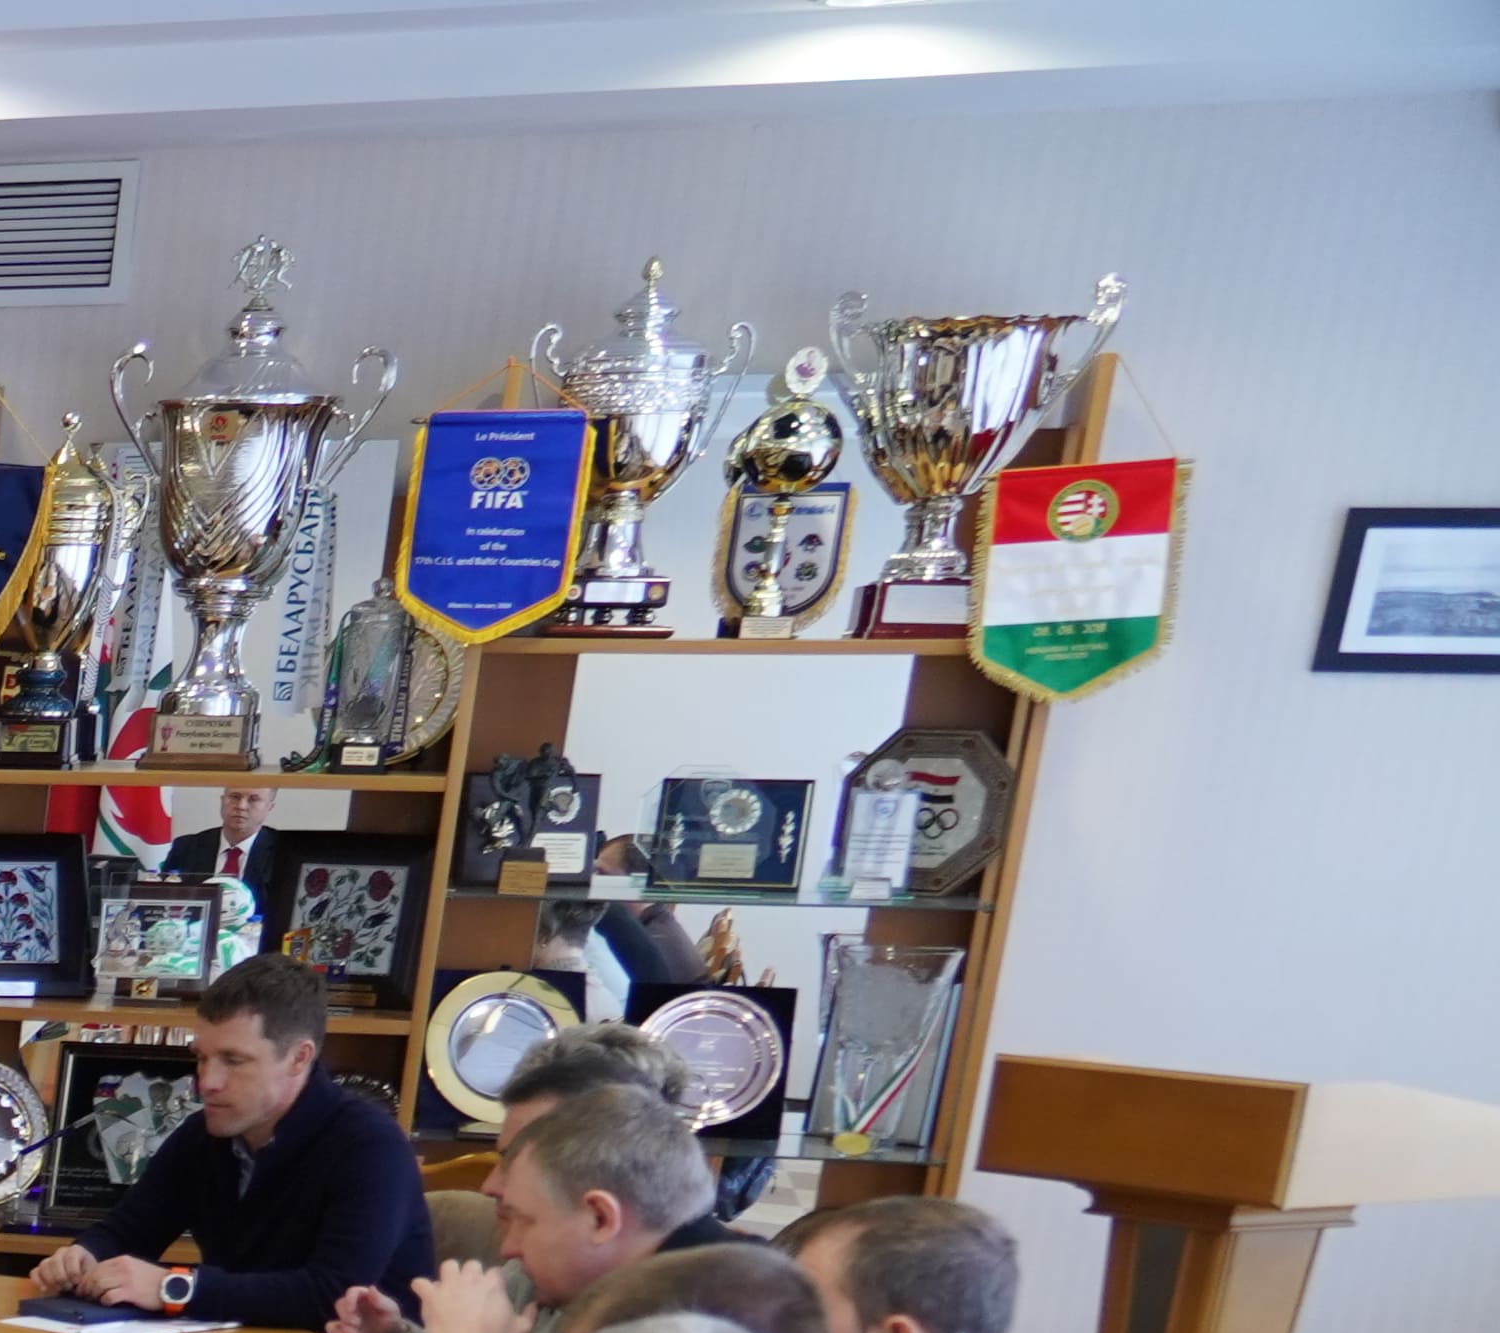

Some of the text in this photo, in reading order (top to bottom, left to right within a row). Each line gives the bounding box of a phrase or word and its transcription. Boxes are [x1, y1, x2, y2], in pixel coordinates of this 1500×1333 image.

[470, 491, 524, 510] FIFA
[475, 527, 526, 536] celebration
[479, 541, 508, 551] of the
